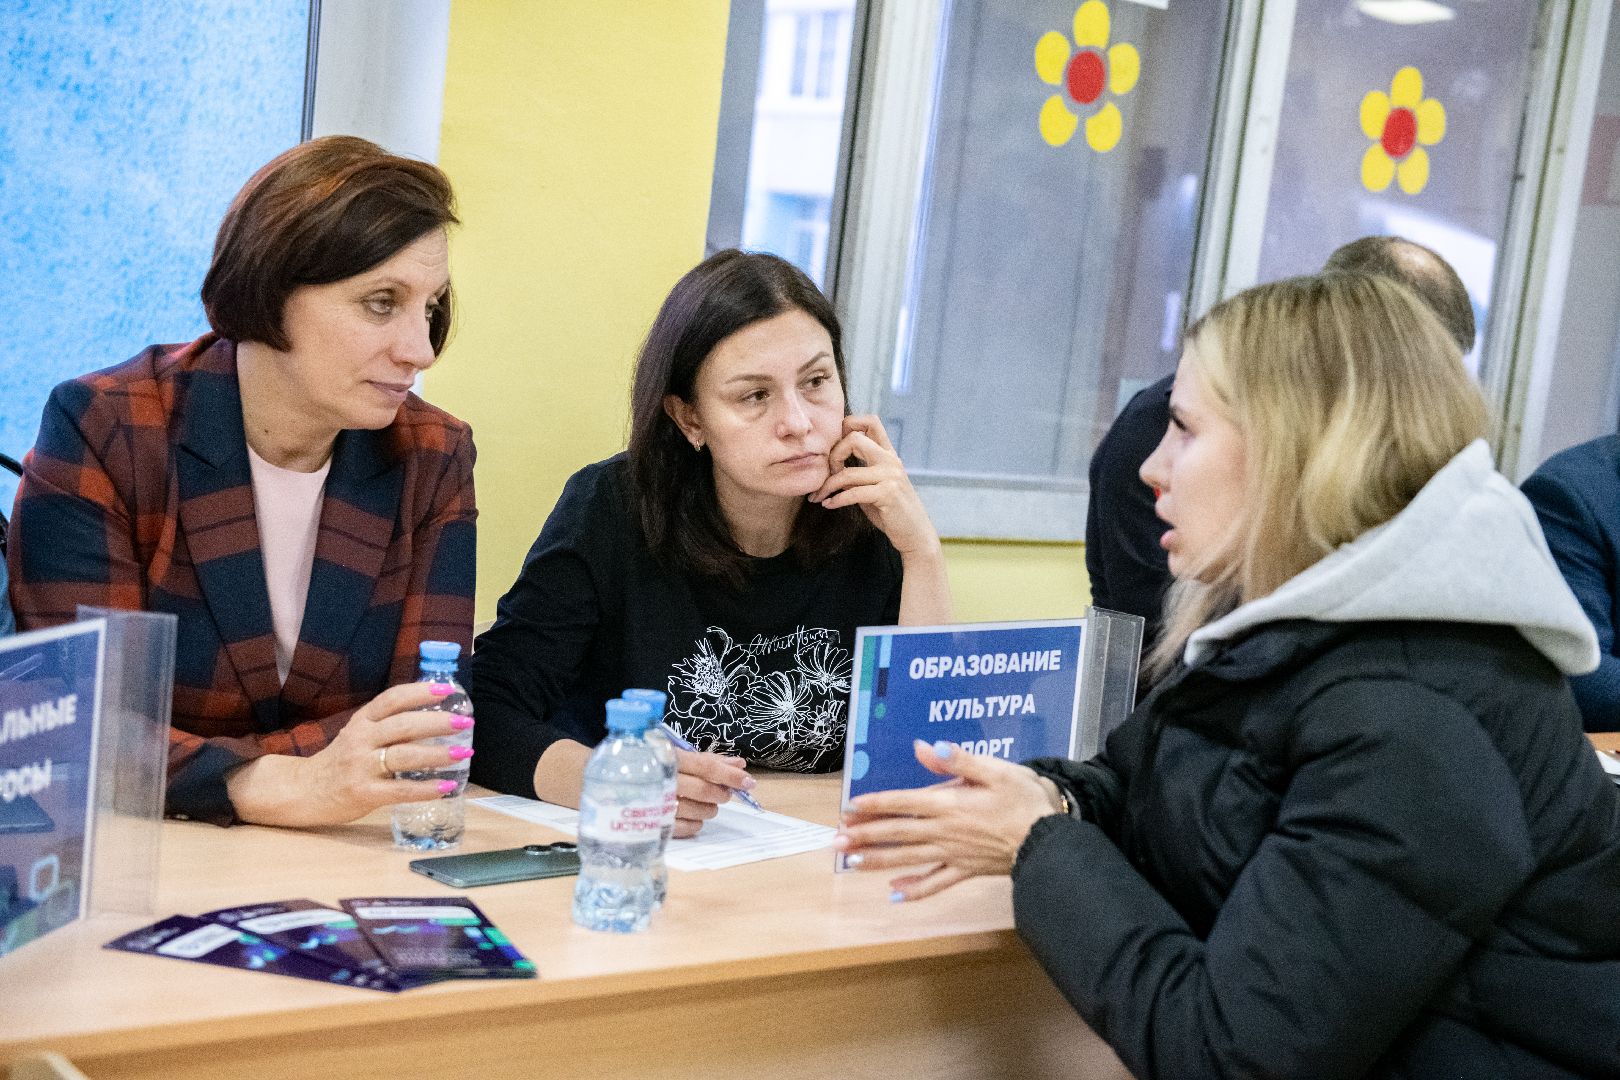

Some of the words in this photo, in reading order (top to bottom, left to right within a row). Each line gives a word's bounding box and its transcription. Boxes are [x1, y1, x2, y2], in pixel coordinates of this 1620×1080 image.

[909, 649, 1062, 680] ОБРАЗОВАНИЕ
[928, 693, 1036, 723] КУЛЬТУРА
[957, 737, 1015, 759] ПОРТ
